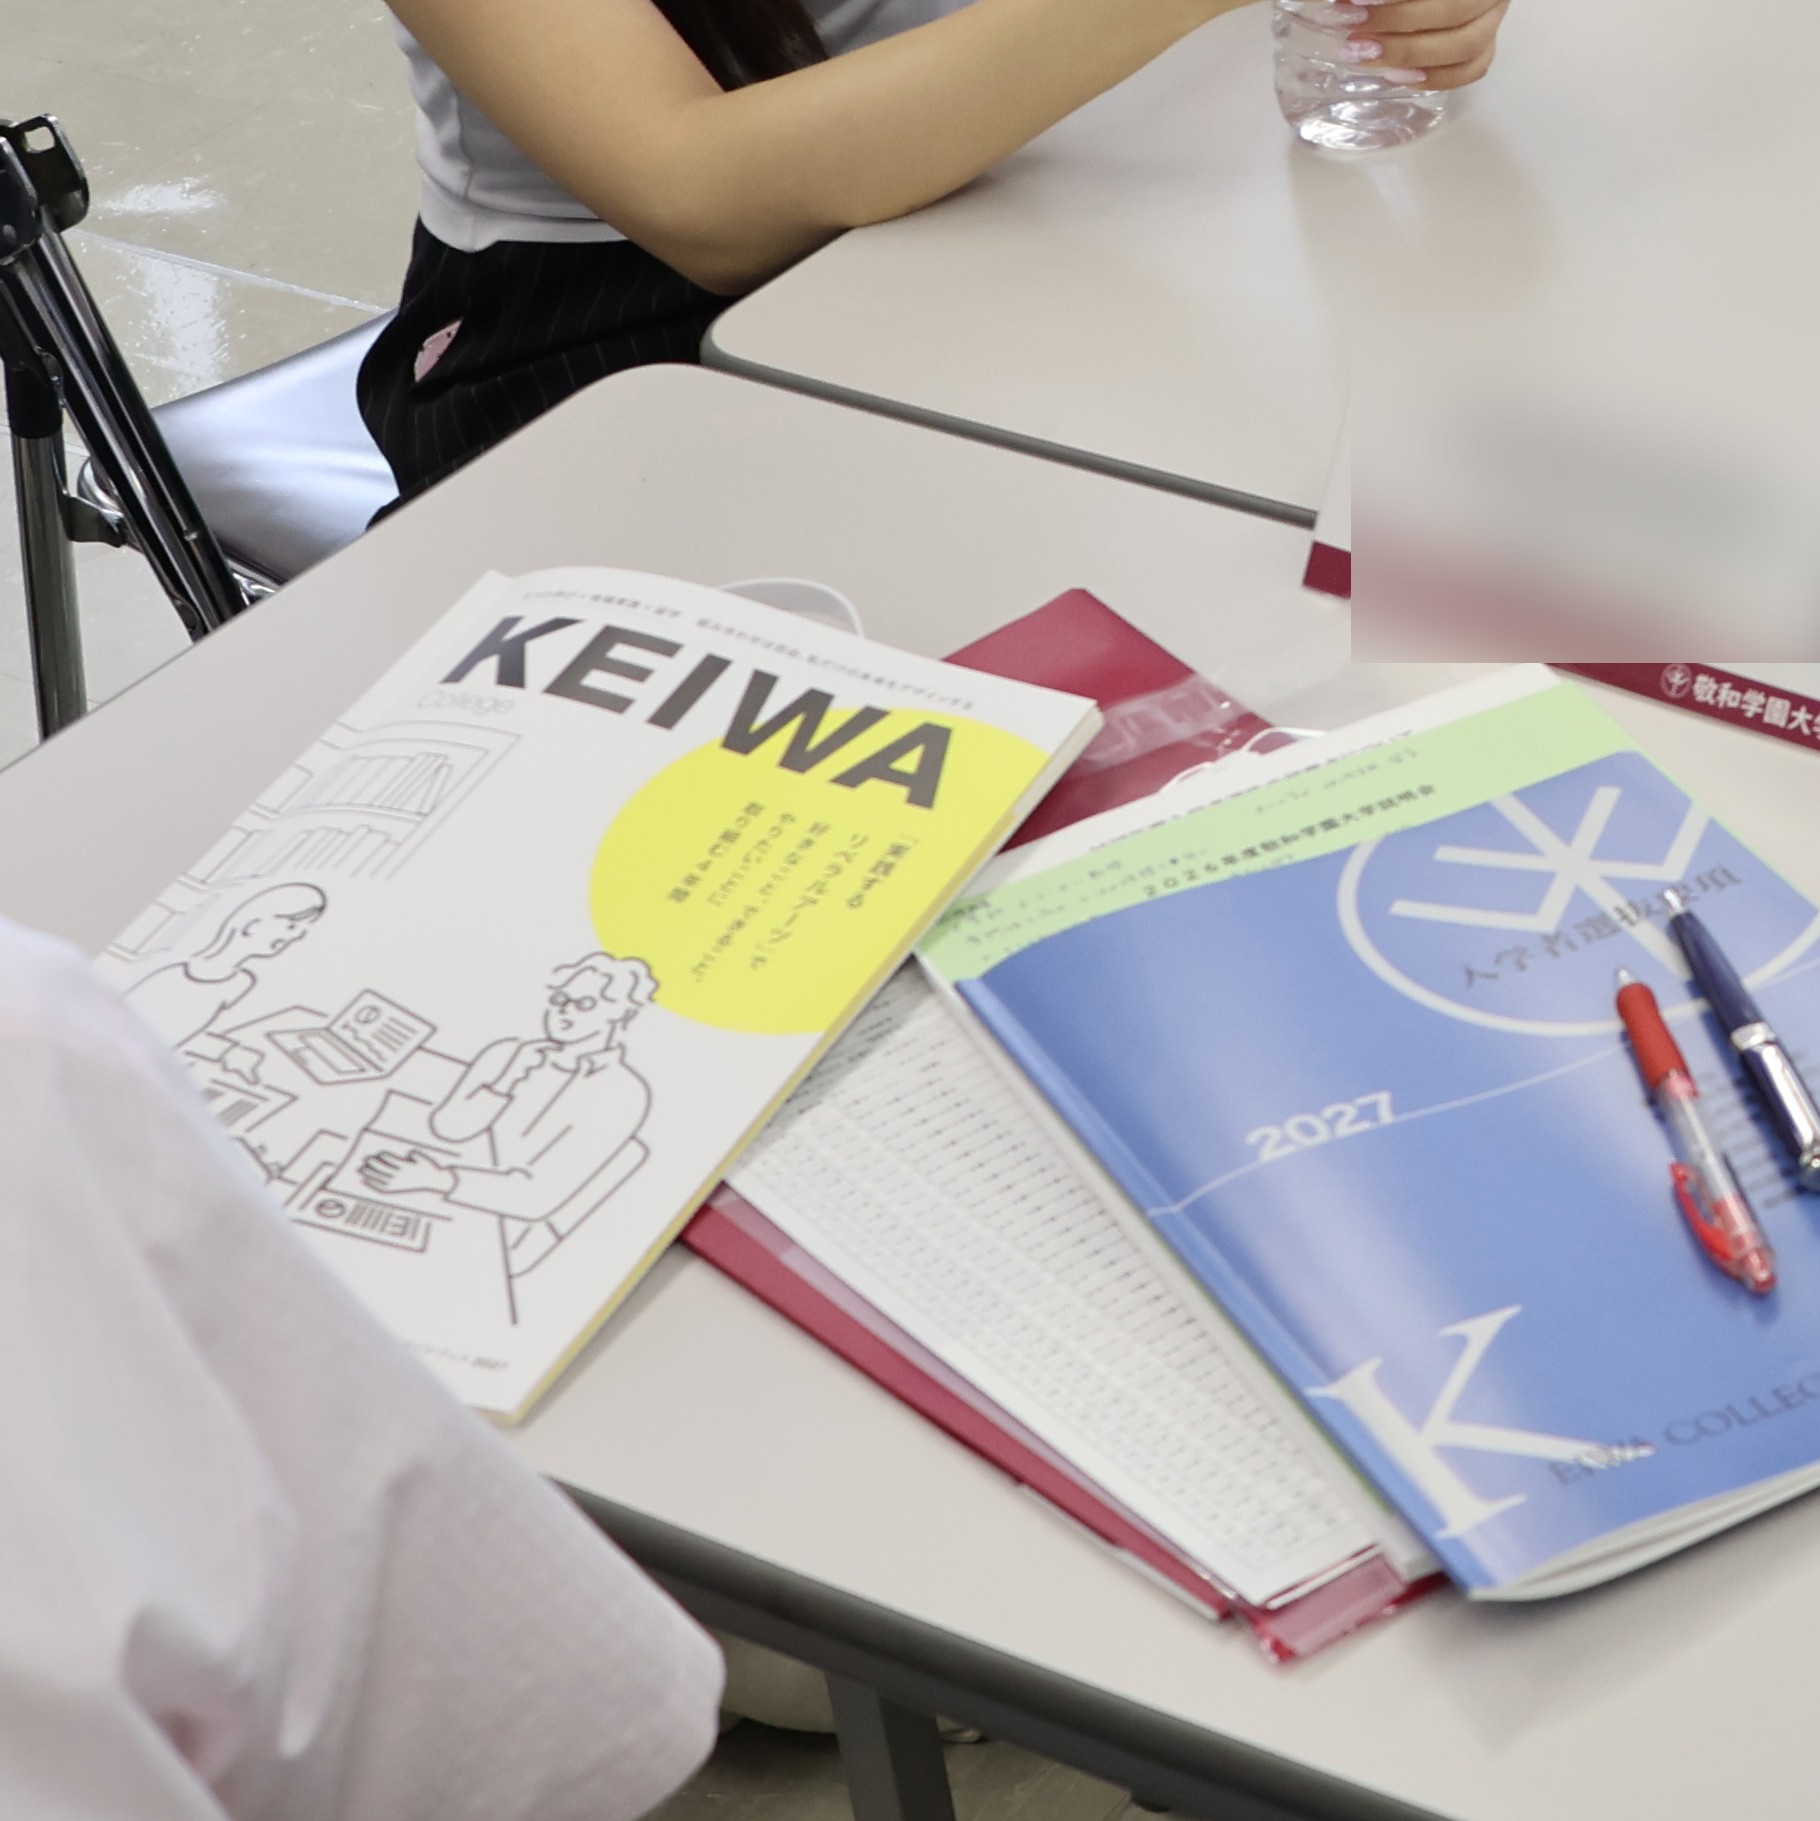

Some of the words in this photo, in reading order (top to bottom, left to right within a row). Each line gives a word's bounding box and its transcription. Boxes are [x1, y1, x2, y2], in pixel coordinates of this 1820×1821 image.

[438, 614, 954, 811] KEIWA
[1246, 1091, 1400, 1164] 2027
[1305, 1305, 1655, 1539] K
